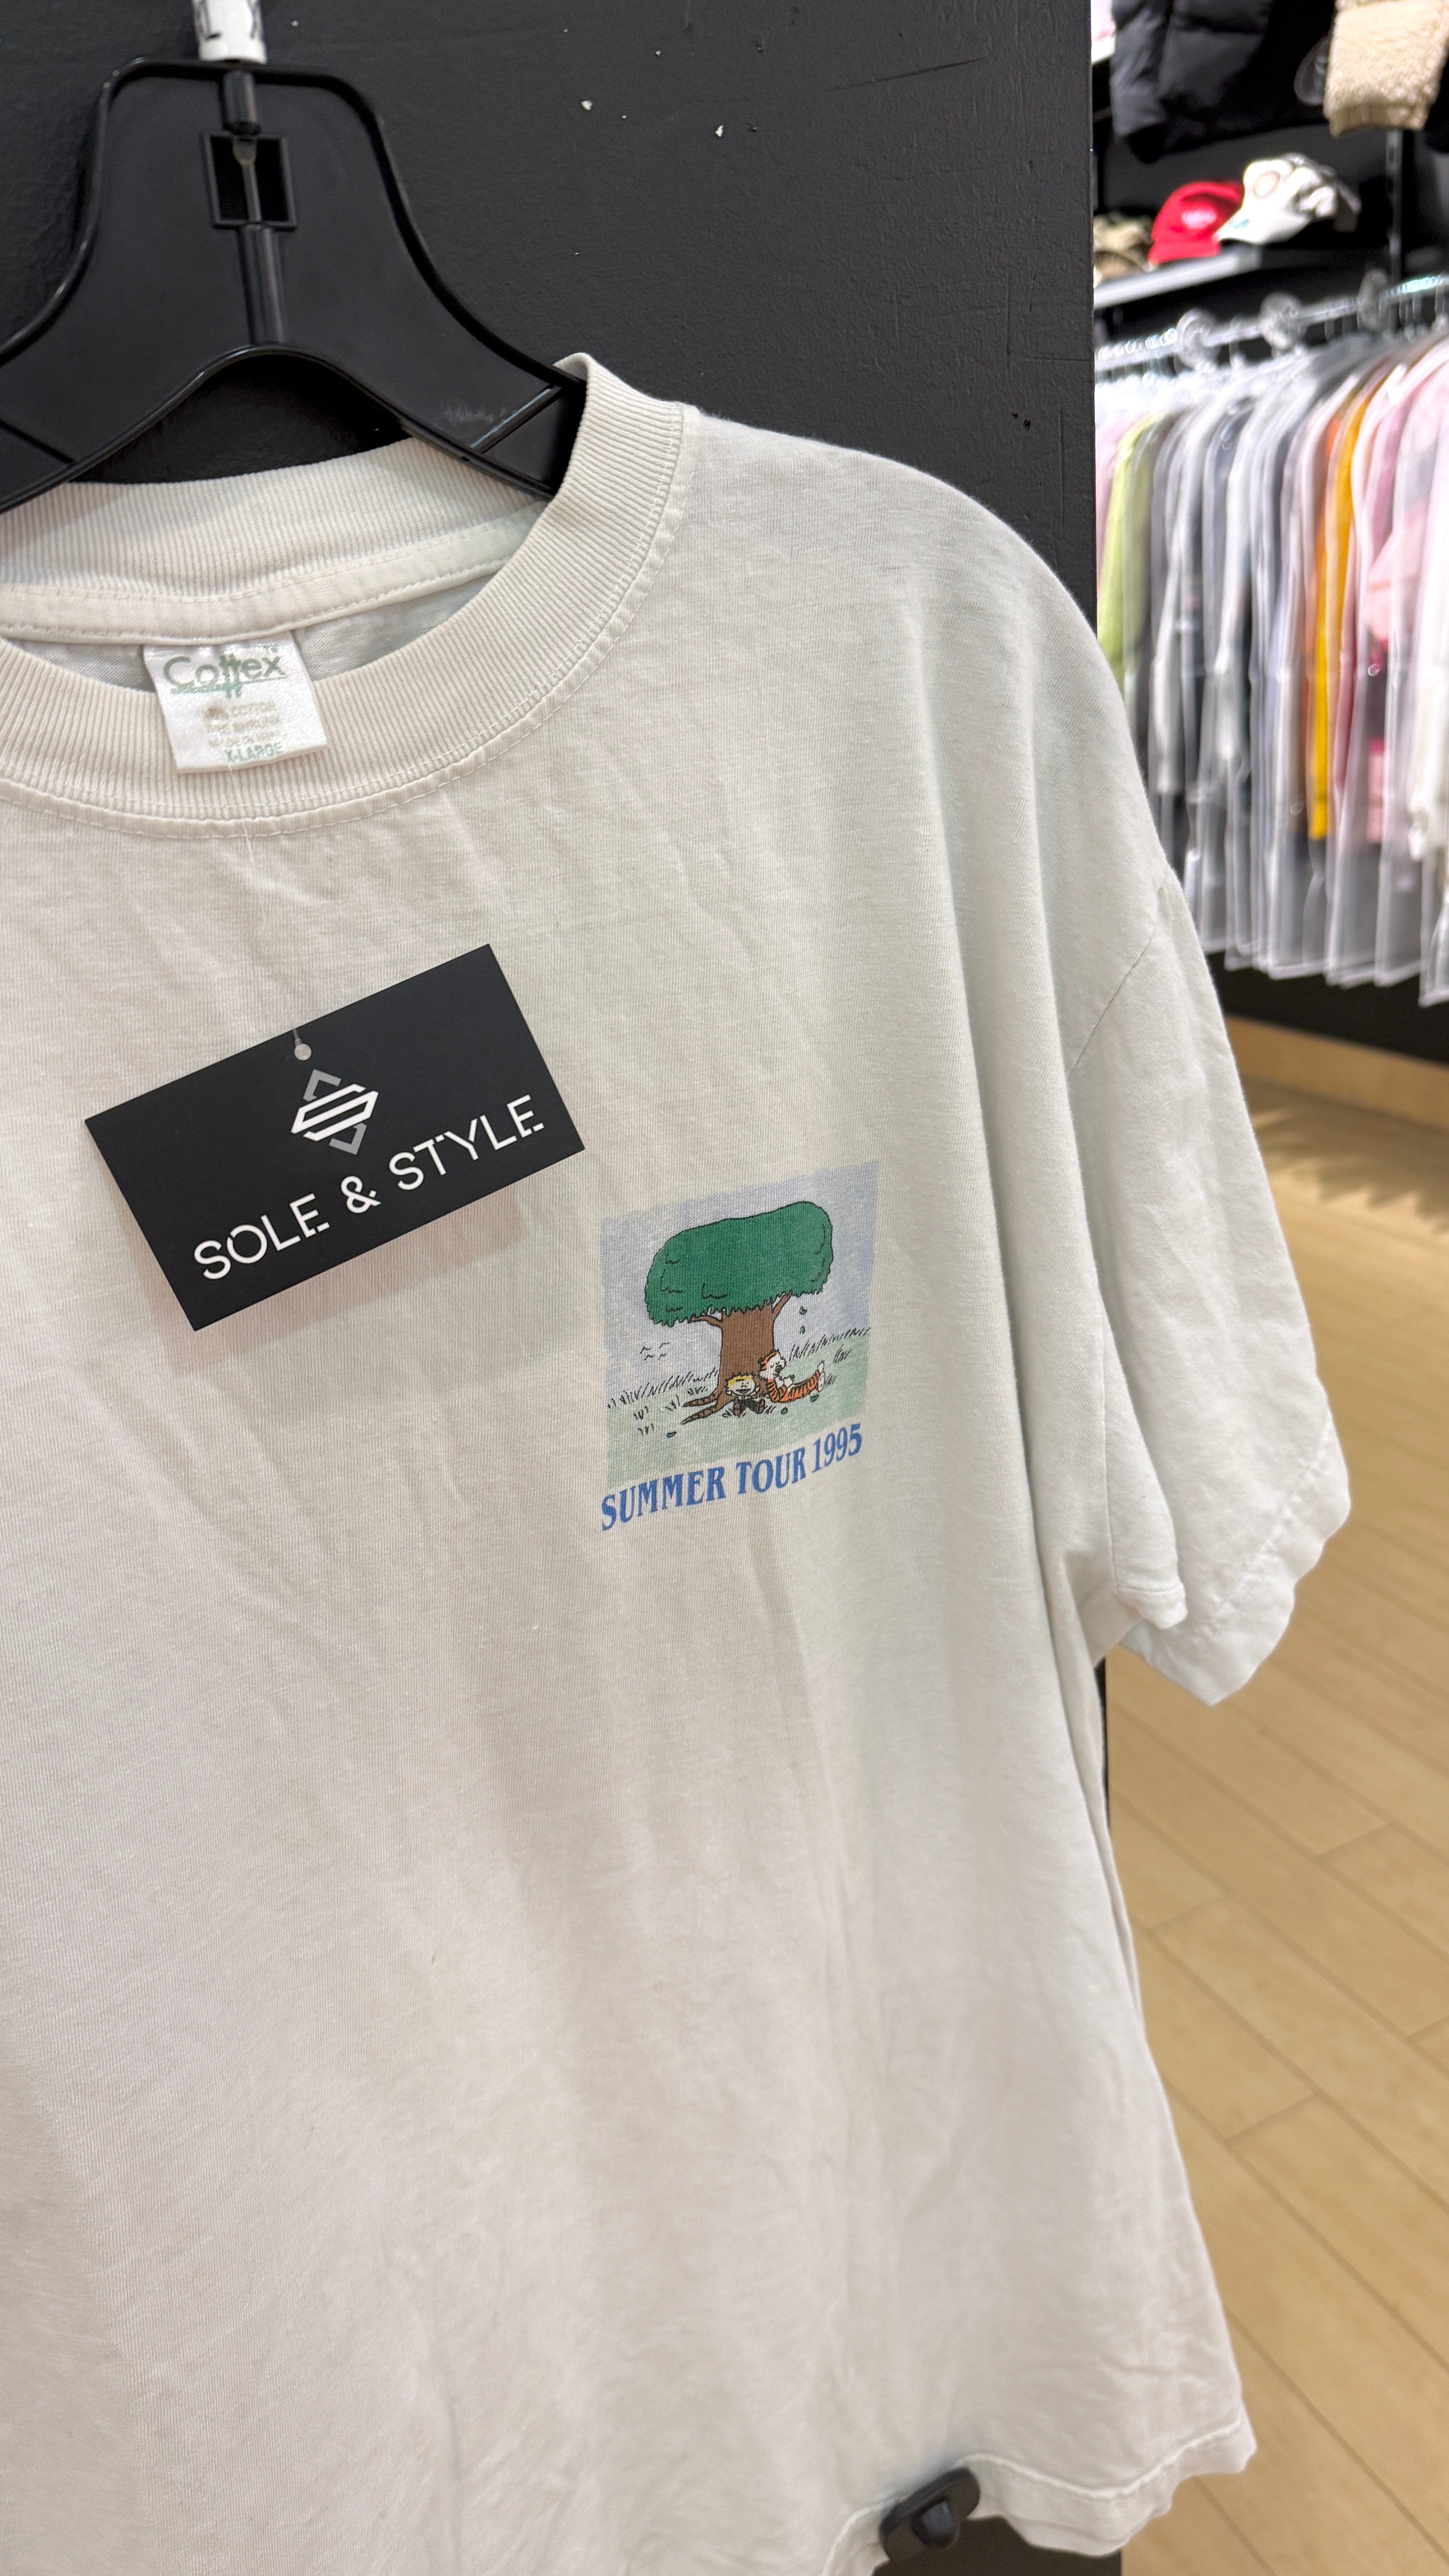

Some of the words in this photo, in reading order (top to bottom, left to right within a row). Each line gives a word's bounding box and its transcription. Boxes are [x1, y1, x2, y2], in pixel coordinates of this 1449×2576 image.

[163, 652, 288, 687] Cottex
[194, 1193, 330, 1279] SOLE
[340, 1175, 382, 1214] &
[388, 1094, 545, 1191] STYLE
[601, 1466, 726, 1531] SUMMER
[735, 1446, 806, 1495] TOUR
[812, 1423, 862, 1472] 1995
